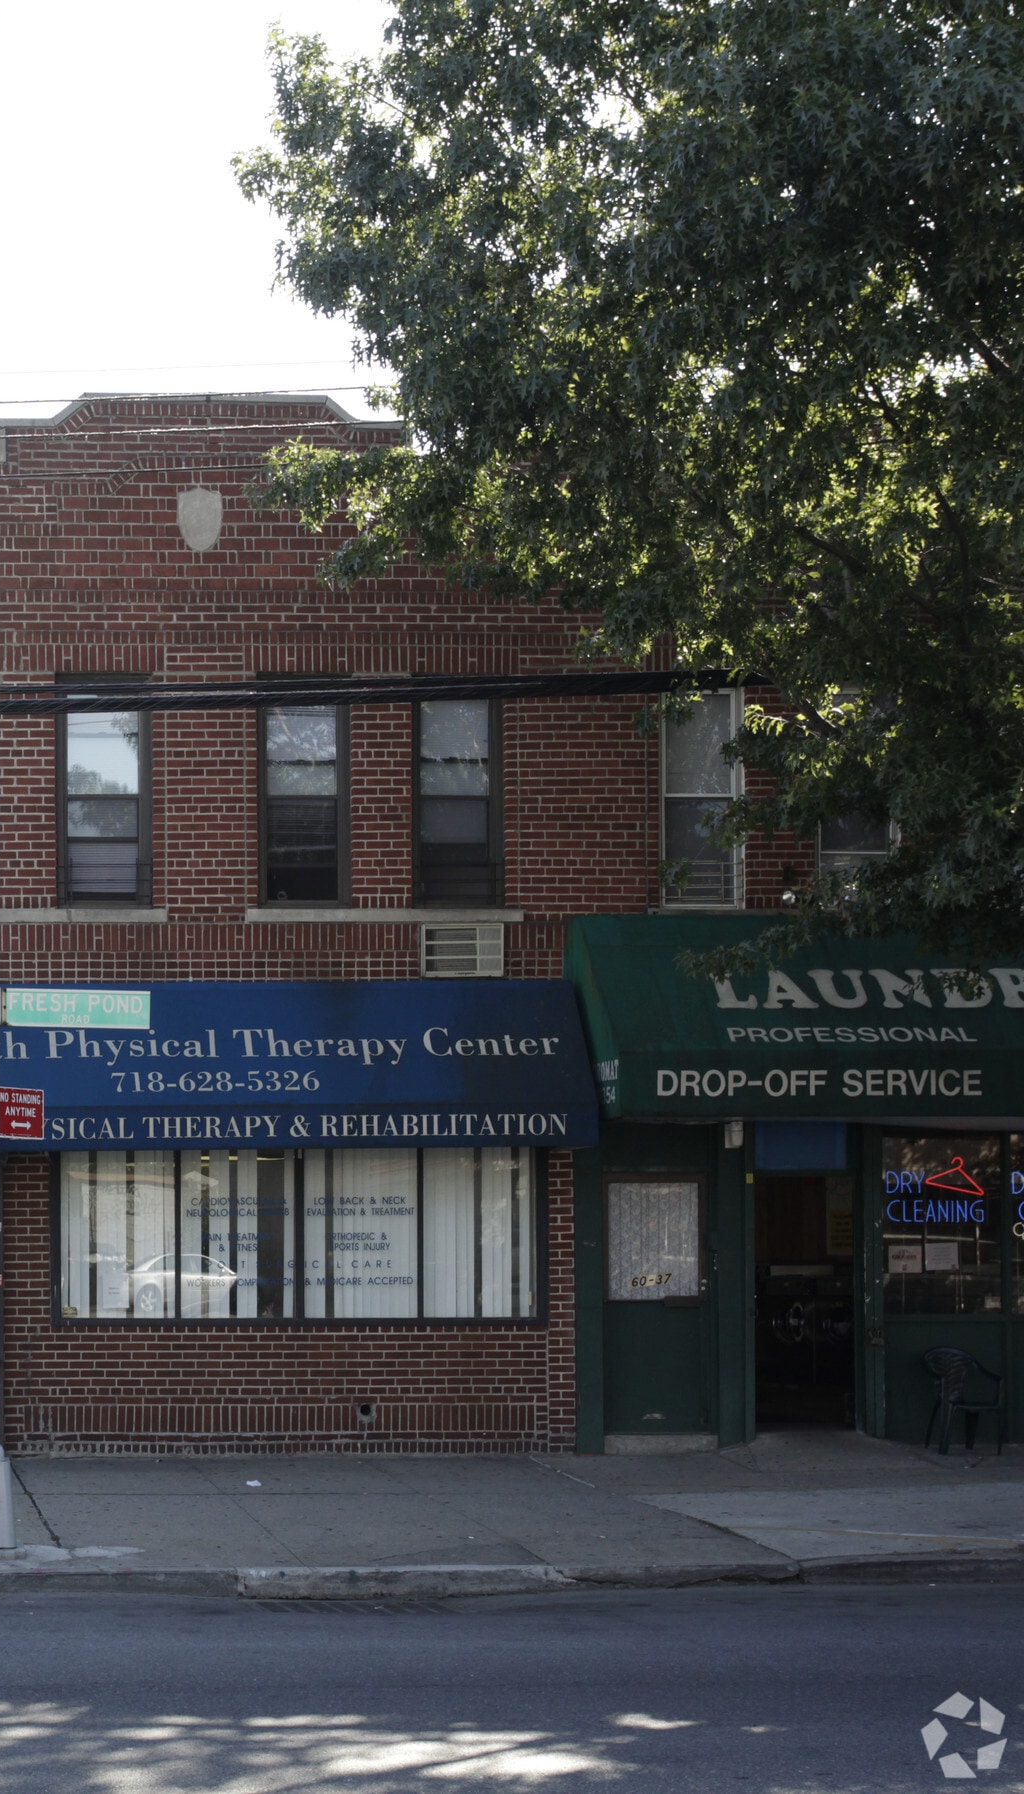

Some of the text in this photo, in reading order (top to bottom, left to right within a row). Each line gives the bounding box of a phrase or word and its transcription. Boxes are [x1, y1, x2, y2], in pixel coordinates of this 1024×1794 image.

[8, 992, 144, 1015] FRESH POND
[61, 1014, 90, 1025] ROAD
[726, 1026, 978, 1043] PROFESSIONAL
[44, 1029, 217, 1066] Physical
[232, 1028, 407, 1066] Therapy
[422, 1027, 560, 1058] Center
[110, 1070, 321, 1093] 718-628-5326
[656, 1068, 983, 1097] DROP-OFF SERVICE
[0, 1091, 41, 1105] NO STANDING
[4, 1106, 37, 1118] ANYTIME
[142, 1115, 281, 1140] THERAPY
[289, 1114, 311, 1138] &
[320, 1113, 569, 1137] REHABILITATION
[885, 1169, 925, 1194] DRY
[190, 1196, 275, 1207] CARDIOVASCU
[339, 1196, 365, 1205] BACK
[369, 1196, 377, 1205] &
[382, 1196, 407, 1205] NECK
[186, 1208, 257, 1218] NEUOLOICAL
[359, 1207, 366, 1216] &
[371, 1207, 415, 1216] TREATMENT
[886, 1199, 985, 1224] CLEANING
[202, 1231, 273, 1241] AIN TEATM
[380, 1231, 388, 1241] &
[218, 1243, 226, 1252] &
[363, 1242, 391, 1251] INJURY
[351, 1259, 392, 1269] CARE
[316, 1277, 362, 1286] MDICARE
[367, 1276, 414, 1286] ACCEPTED
[631, 1273, 672, 1288] 60-37
